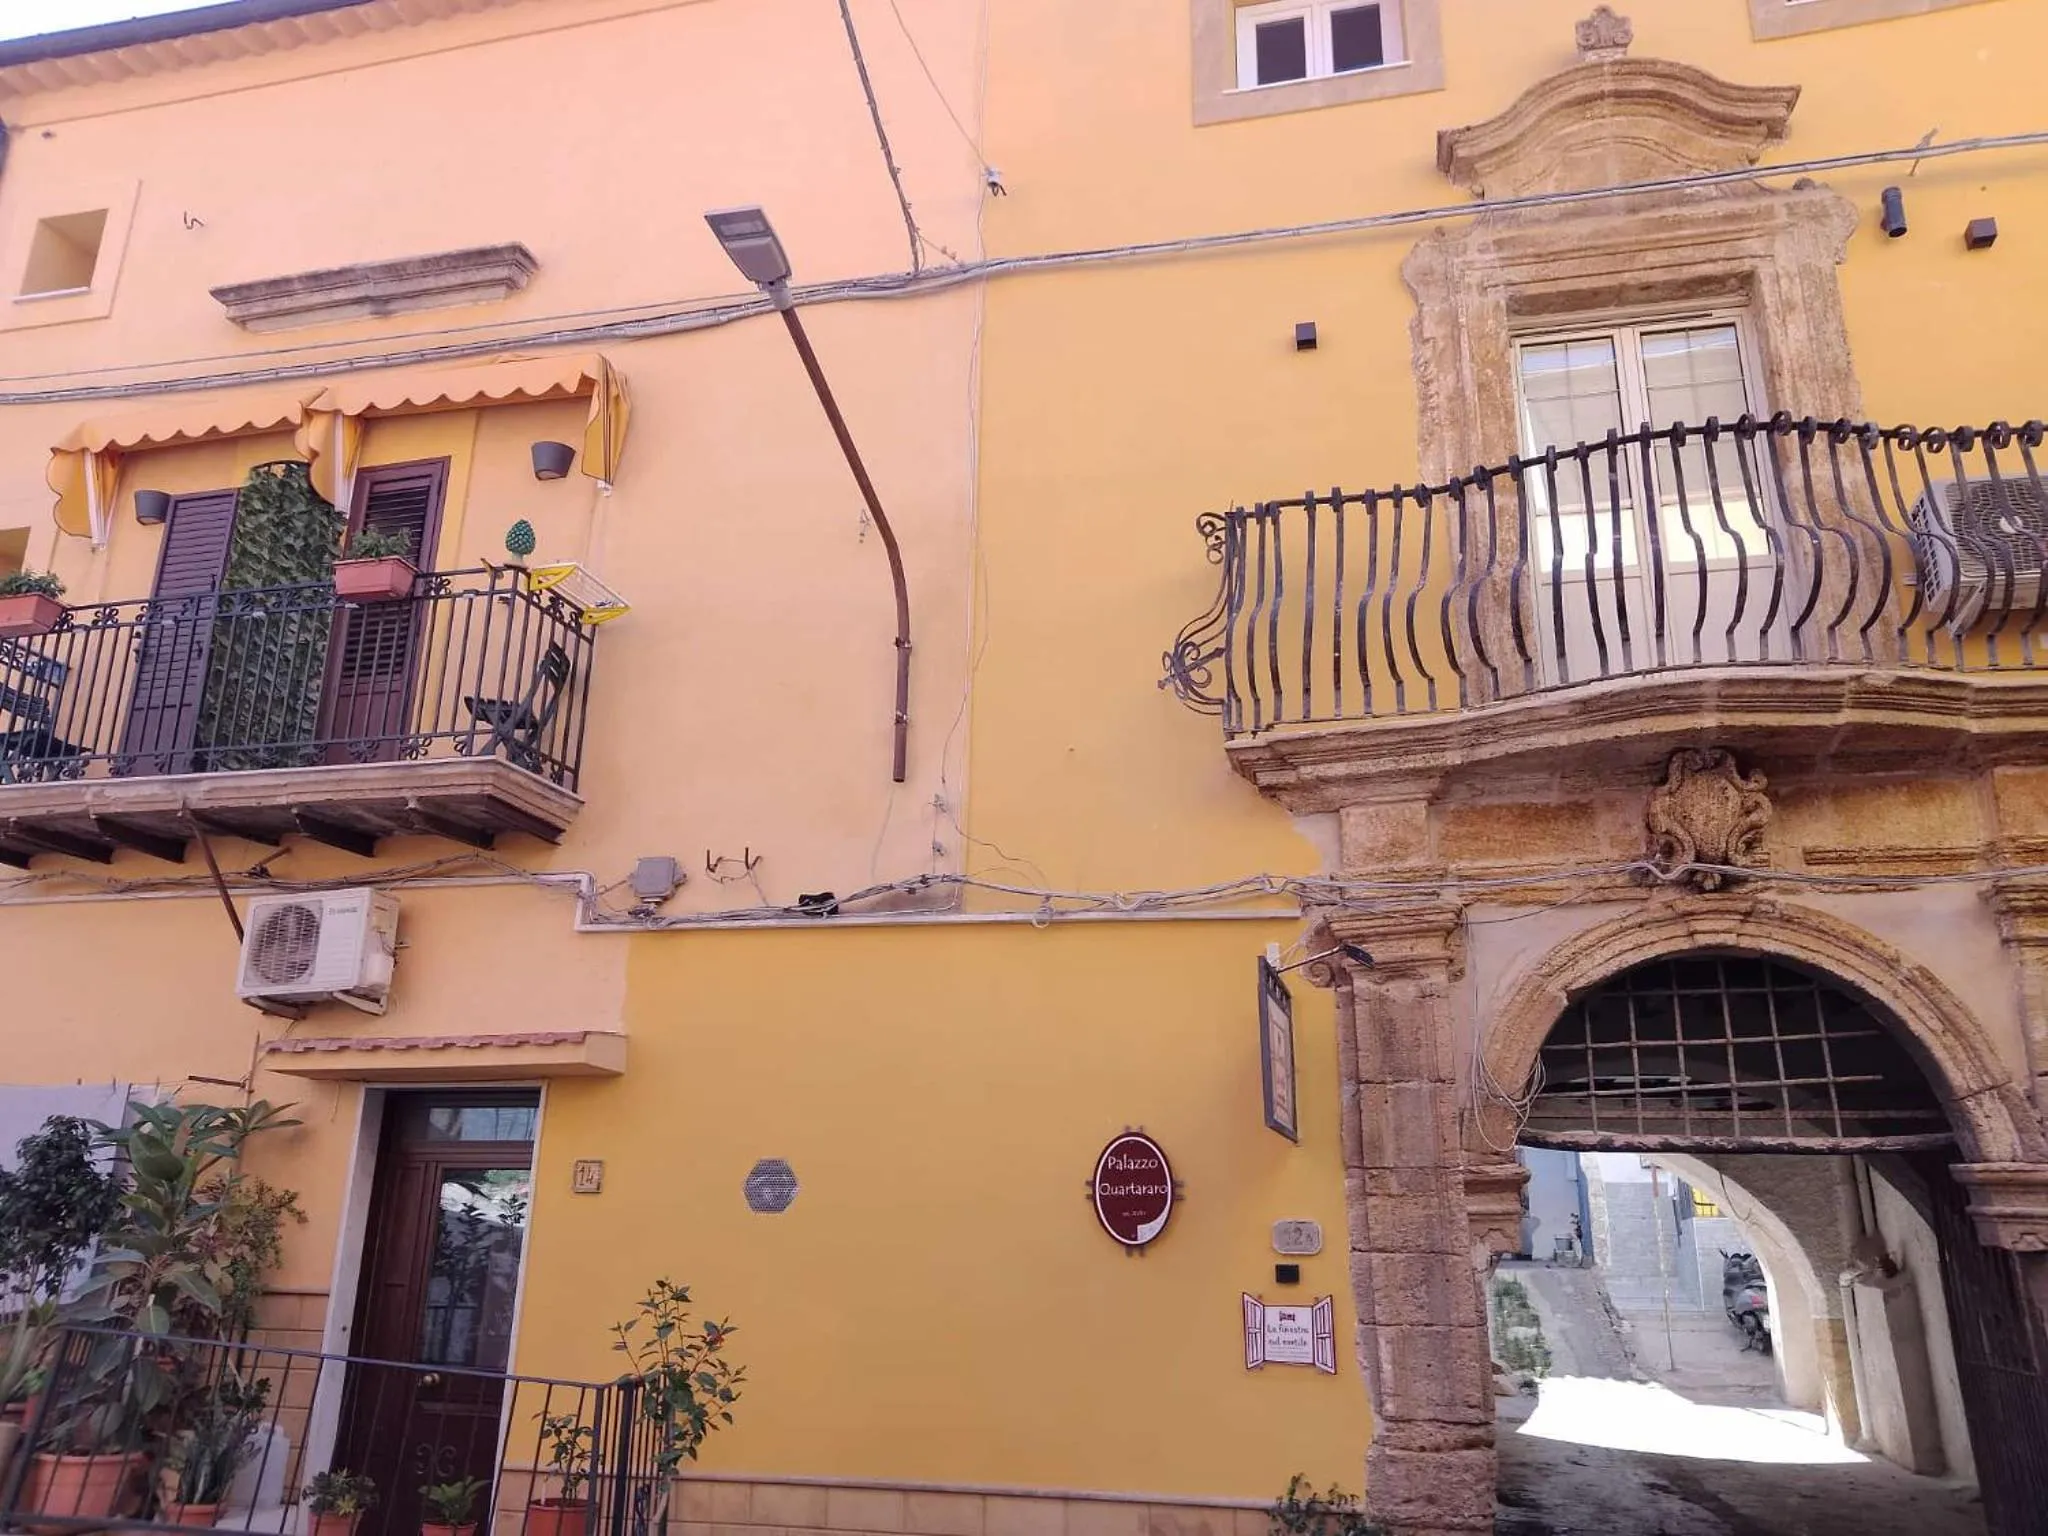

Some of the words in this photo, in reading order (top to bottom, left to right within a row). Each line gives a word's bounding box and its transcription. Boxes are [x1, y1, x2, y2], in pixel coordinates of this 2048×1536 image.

[1108, 1153, 1158, 1170] Palazzo
[578, 1165, 594, 1186] 14
[1100, 1183, 1168, 1196] Quartararo
